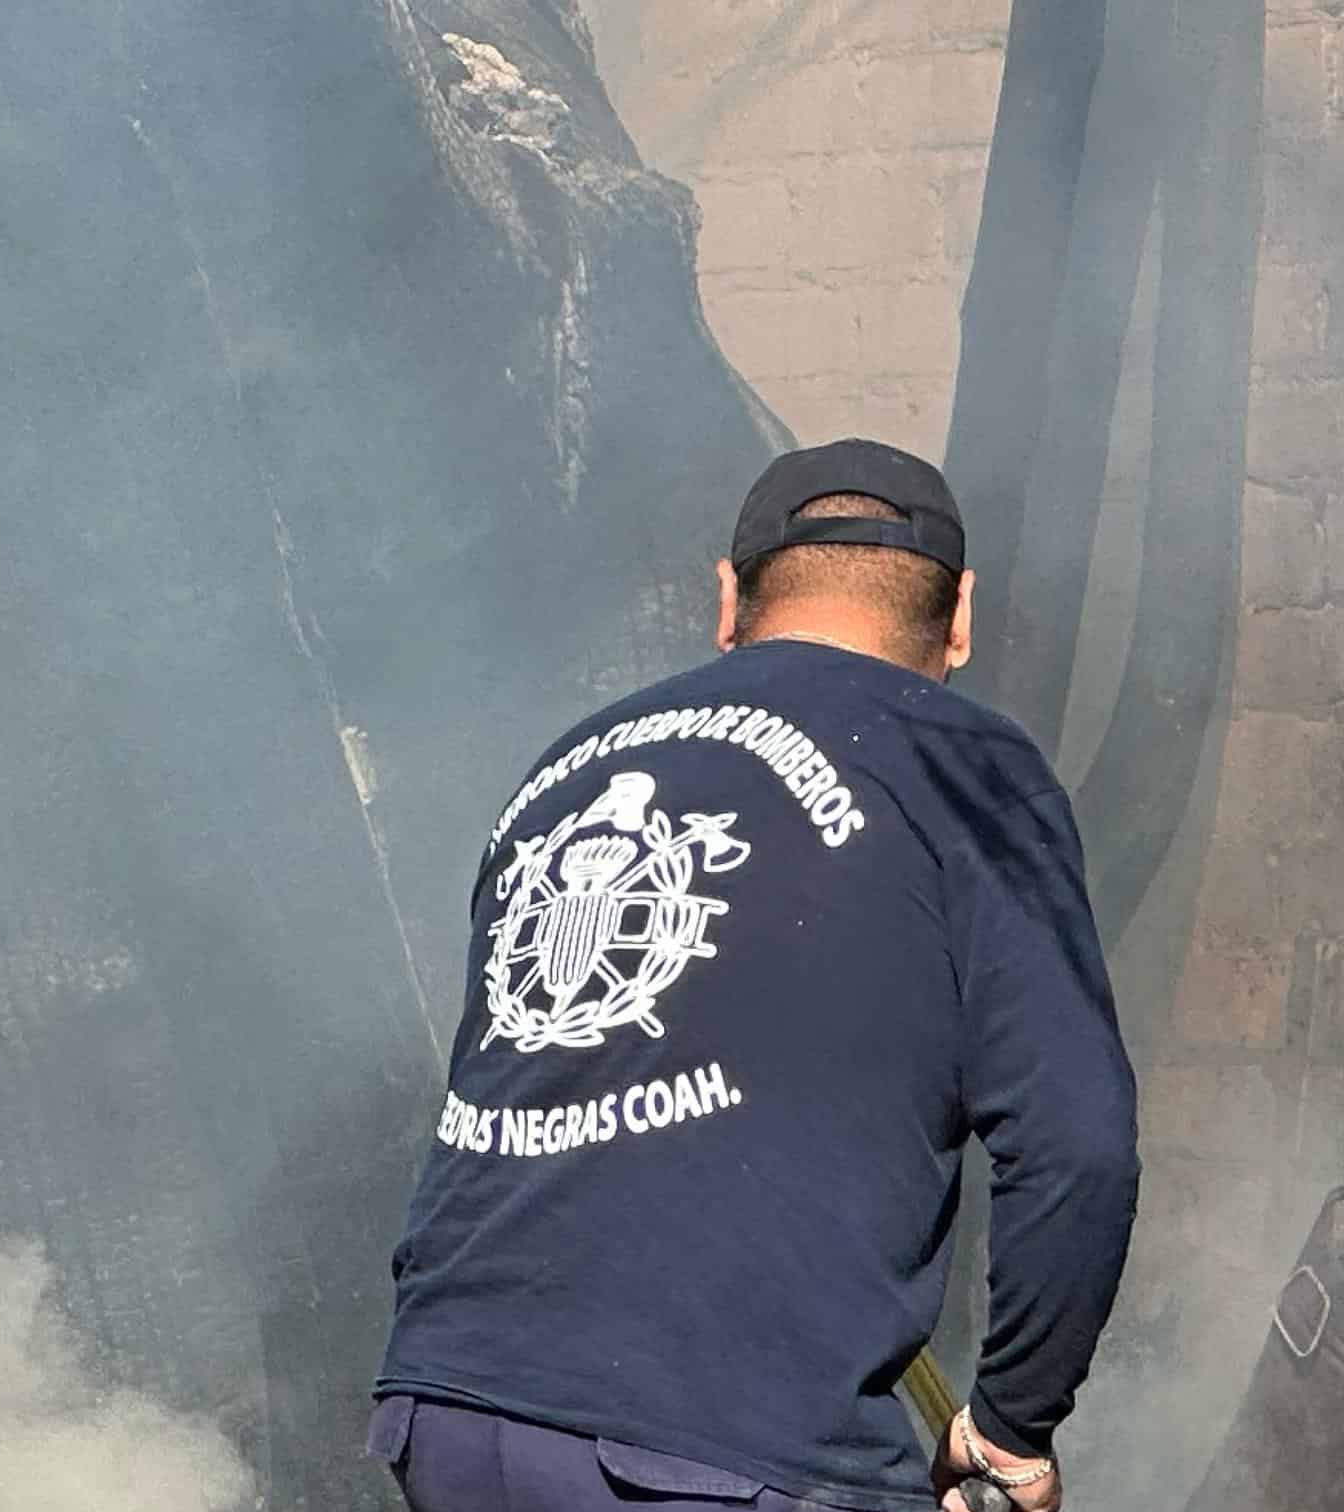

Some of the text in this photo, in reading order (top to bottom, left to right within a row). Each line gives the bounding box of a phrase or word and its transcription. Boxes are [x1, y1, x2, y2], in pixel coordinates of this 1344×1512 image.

[597, 706, 713, 758] CUERPO
[696, 704, 751, 740] DE
[728, 707, 865, 848] BOMBEROS
[498, 1093, 618, 1157] NEGRAS
[622, 1061, 742, 1135] COAH.
